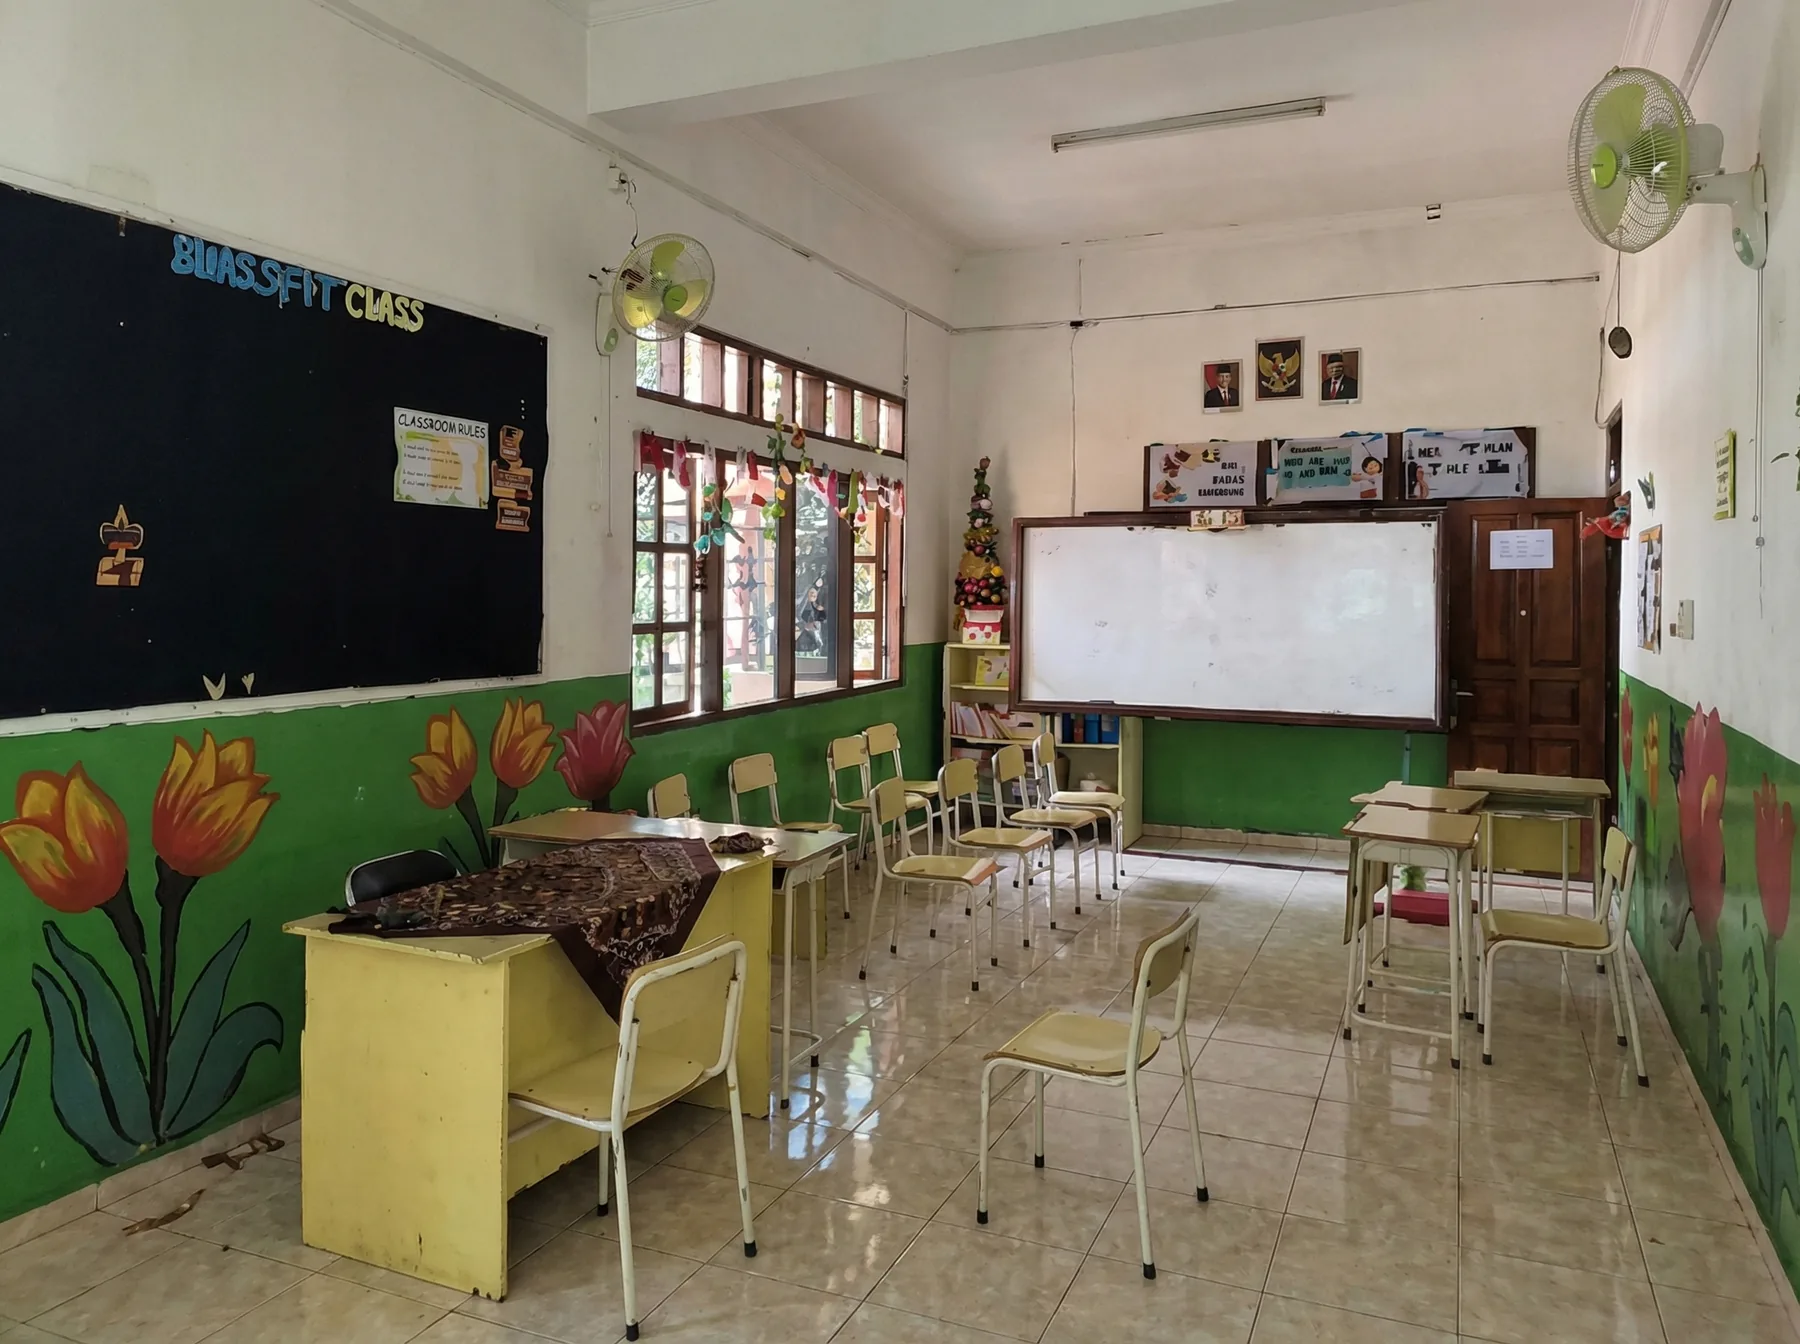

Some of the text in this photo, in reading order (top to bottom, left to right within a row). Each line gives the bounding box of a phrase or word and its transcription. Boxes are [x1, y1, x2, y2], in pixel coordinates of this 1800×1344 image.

[345, 284, 424, 332] CLASS
[398, 414, 486, 439] CLASSROOM RULES
